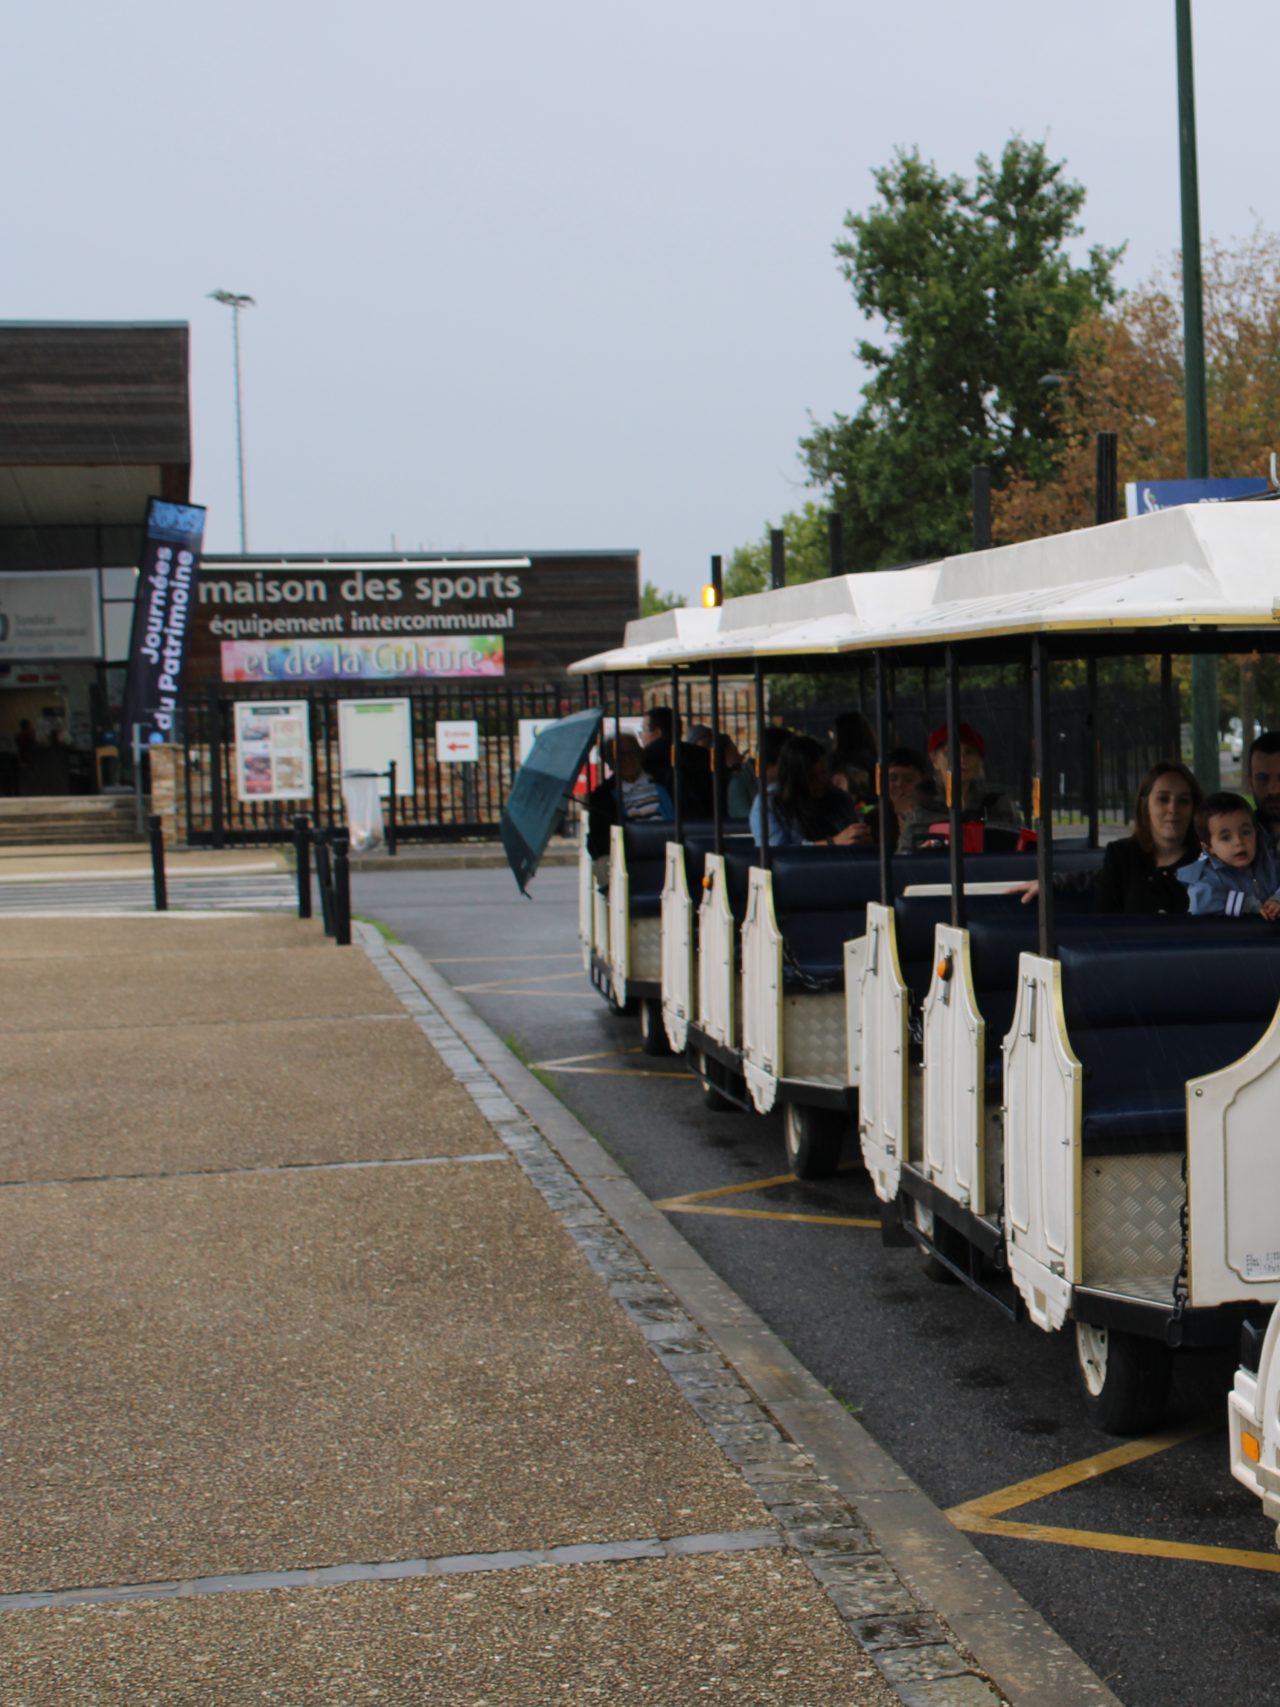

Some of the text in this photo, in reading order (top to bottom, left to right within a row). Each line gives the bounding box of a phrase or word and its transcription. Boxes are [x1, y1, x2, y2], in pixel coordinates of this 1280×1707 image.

[141, 546, 172, 664] Journées
[198, 570, 522, 607] maison des sports
[154, 550, 194, 731] du Patrimoine
[209, 607, 515, 638] équipement intercommunal
[244, 641, 484, 676] et de la Culture
